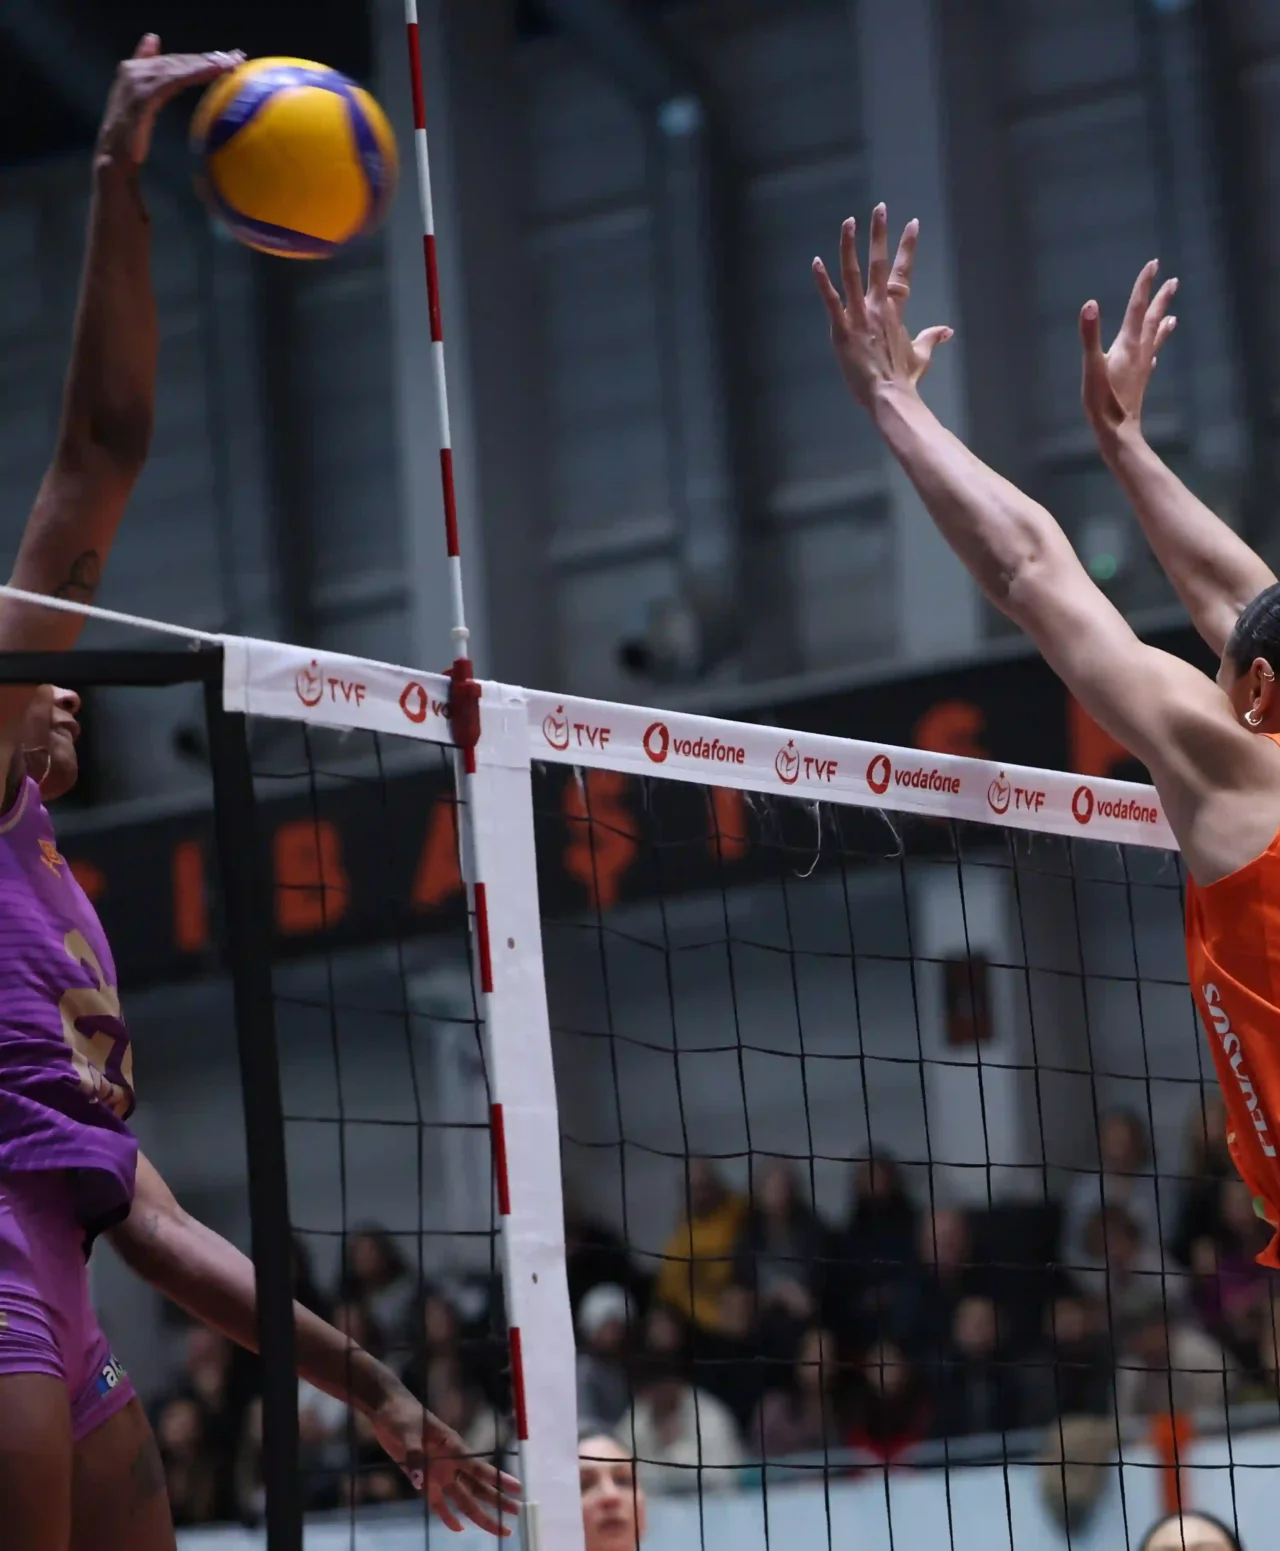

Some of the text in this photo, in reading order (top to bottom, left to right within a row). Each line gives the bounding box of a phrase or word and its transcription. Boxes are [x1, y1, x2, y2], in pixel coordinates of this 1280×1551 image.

[327, 678, 367, 703] TVF
[573, 721, 612, 750] TVF
[673, 738, 746, 765] vodafone
[803, 756, 838, 782] TVF
[894, 769, 962, 794] vodafone
[1013, 786, 1047, 812] TVF
[1096, 800, 1159, 825] vodafone
[1201, 983, 1277, 1158] PEGASUS
